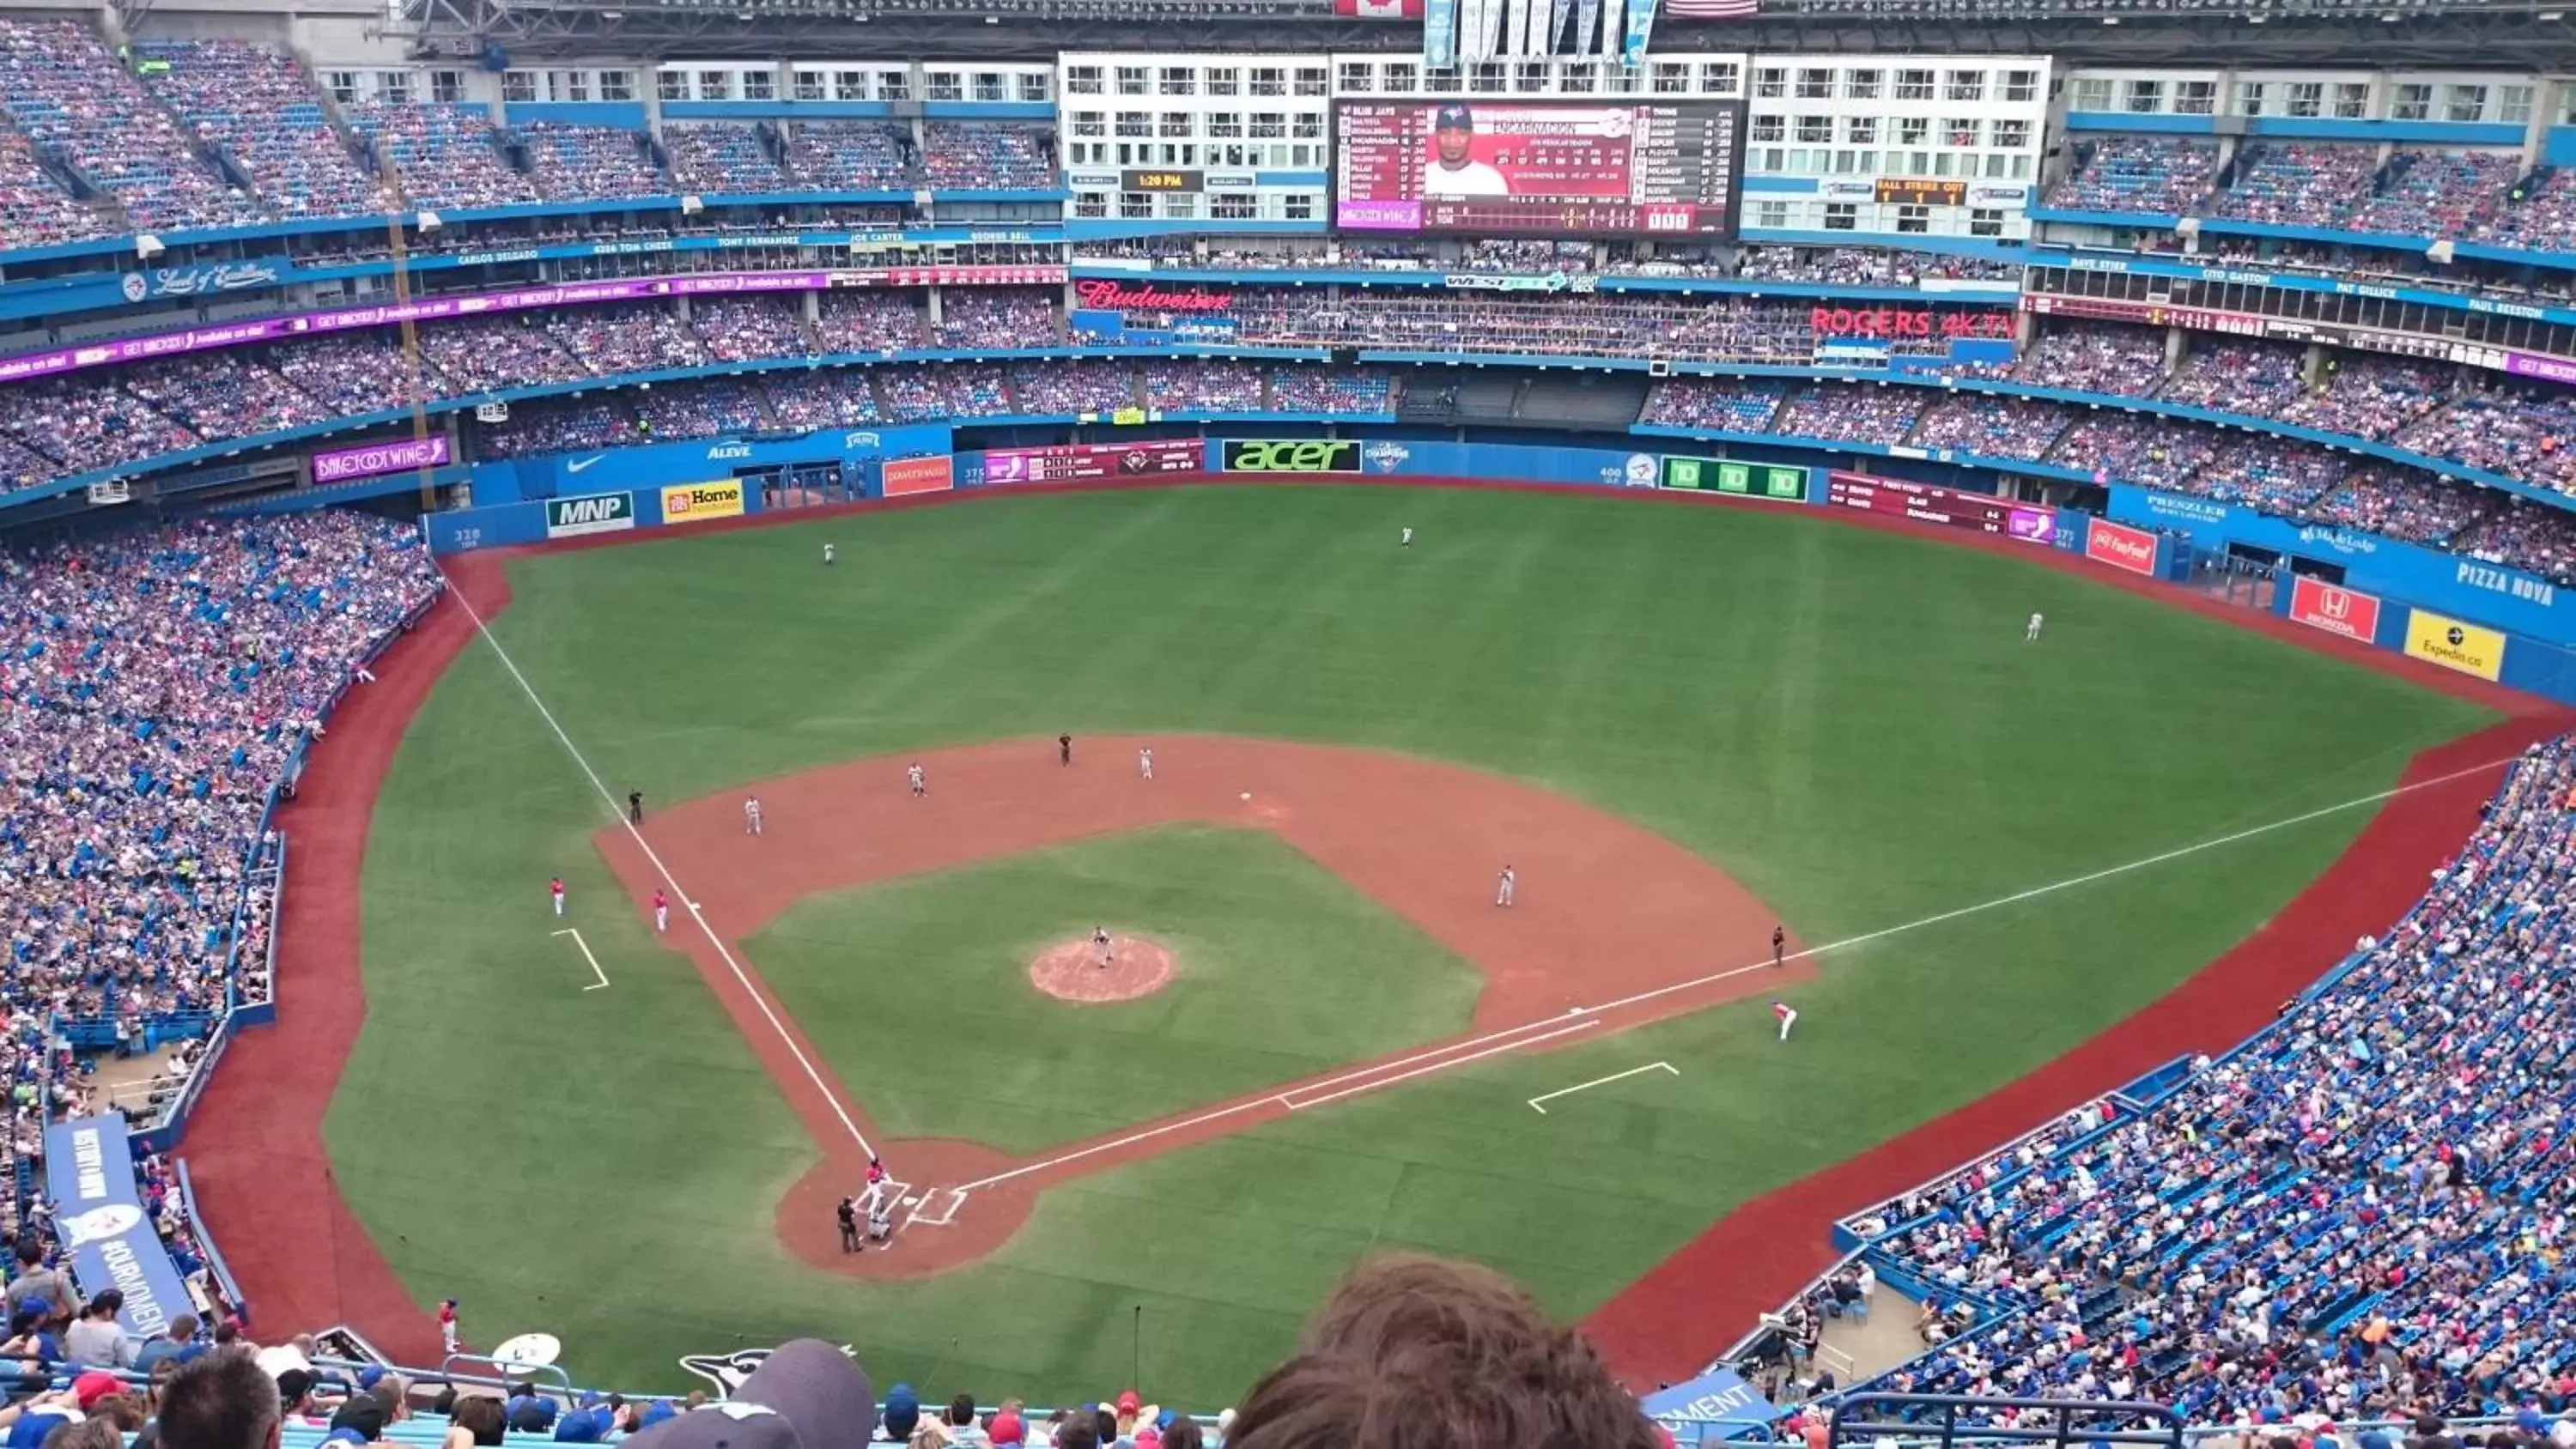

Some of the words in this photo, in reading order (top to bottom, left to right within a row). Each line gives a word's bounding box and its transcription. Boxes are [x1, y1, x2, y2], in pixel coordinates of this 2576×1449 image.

[1139, 175, 1160, 186] 1:20
[1163, 175, 1182, 186] PM
[1878, 179, 1900, 191] BALL
[1905, 181, 1938, 191] STRIKE
[1943, 182, 1965, 193] OUT
[719, 238, 743, 247] TONY
[746, 236, 800, 246] FERNANDEZ
[871, 233, 902, 241] CARTER
[971, 232, 1006, 240] GEORGE
[1011, 232, 1030, 240] BELL
[620, 243, 641, 253] TOM
[644, 241, 673, 252] CHEEK
[459, 253, 494, 265] CARLOS
[496, 250, 538, 263] DELGADO
[2071, 258, 2095, 269] DAVE
[2202, 269, 2225, 281] CITO
[2229, 271, 2271, 283] GASTON
[1078, 281, 1234, 309] Budweiser
[2336, 282, 2355, 294] PAT
[2359, 285, 2397, 298] GILLICK
[2469, 299, 2493, 312] PAUL
[2496, 302, 2544, 318] BEESTON
[318, 315, 337, 328] GET
[1811, 306, 1930, 335] ROGERS
[1941, 312, 1978, 336] 4K
[1985, 313, 2019, 339] TV
[2518, 358, 2537, 371] GET
[319, 452, 388, 477] BAREFOOT
[389, 445, 428, 465] WINE
[708, 446, 752, 460] ALEVE
[1235, 440, 1350, 470] acer
[1600, 467, 1622, 478] 400
[1674, 464, 1698, 482] TD
[1724, 469, 1747, 486] TD
[1773, 473, 1796, 490] TD
[690, 488, 738, 505] Home
[559, 497, 622, 525] MNP
[2457, 561, 2506, 593] PIZZA
[2512, 576, 2554, 607] NOVA
[2306, 611, 2356, 636] HONDA
[2422, 640, 2482, 668] Expedia.ca
[100, 1240, 171, 1336] #OURMOMENT
